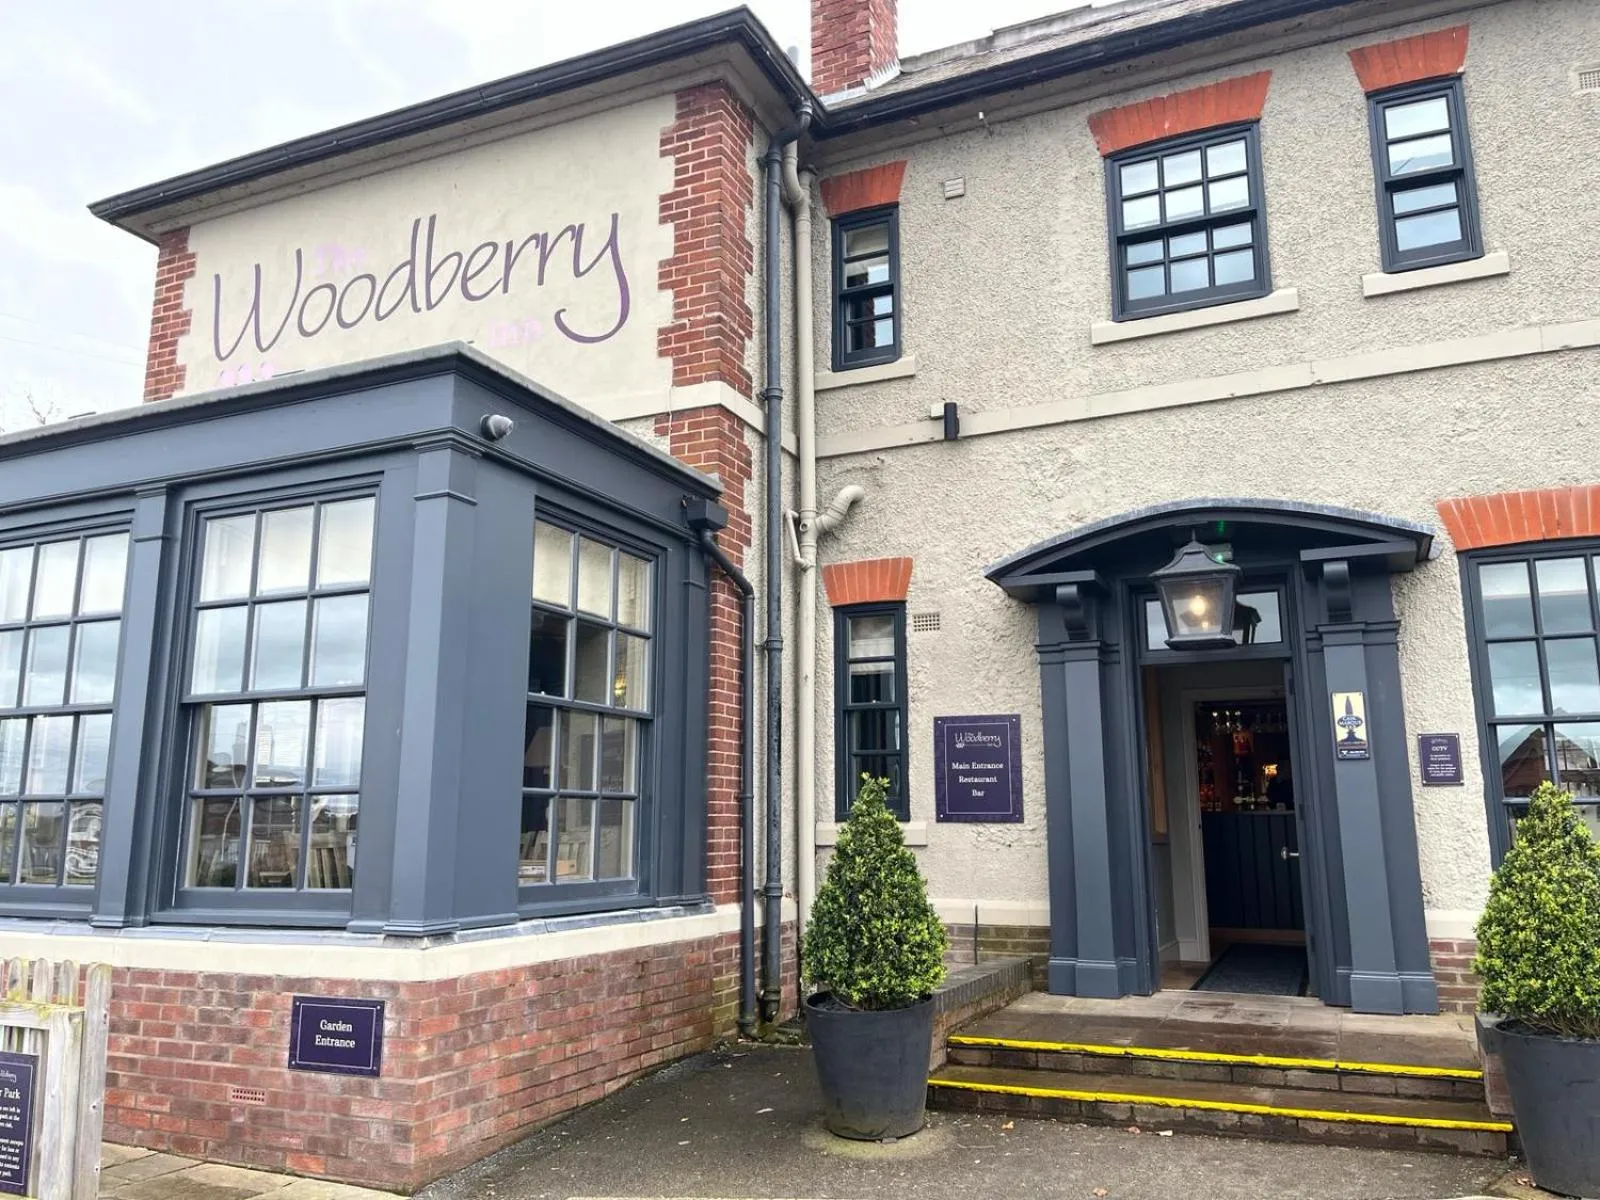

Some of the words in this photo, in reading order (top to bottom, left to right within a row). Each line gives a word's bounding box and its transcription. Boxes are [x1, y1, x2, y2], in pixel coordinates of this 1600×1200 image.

[213, 212, 630, 362] Woodberry
[959, 775, 998, 783] Restaurant
[972, 789, 985, 797] Bar
[320, 1019, 353, 1032] Garden
[315, 1034, 356, 1048] Entrance
[4, 1087, 21, 1100] Park
